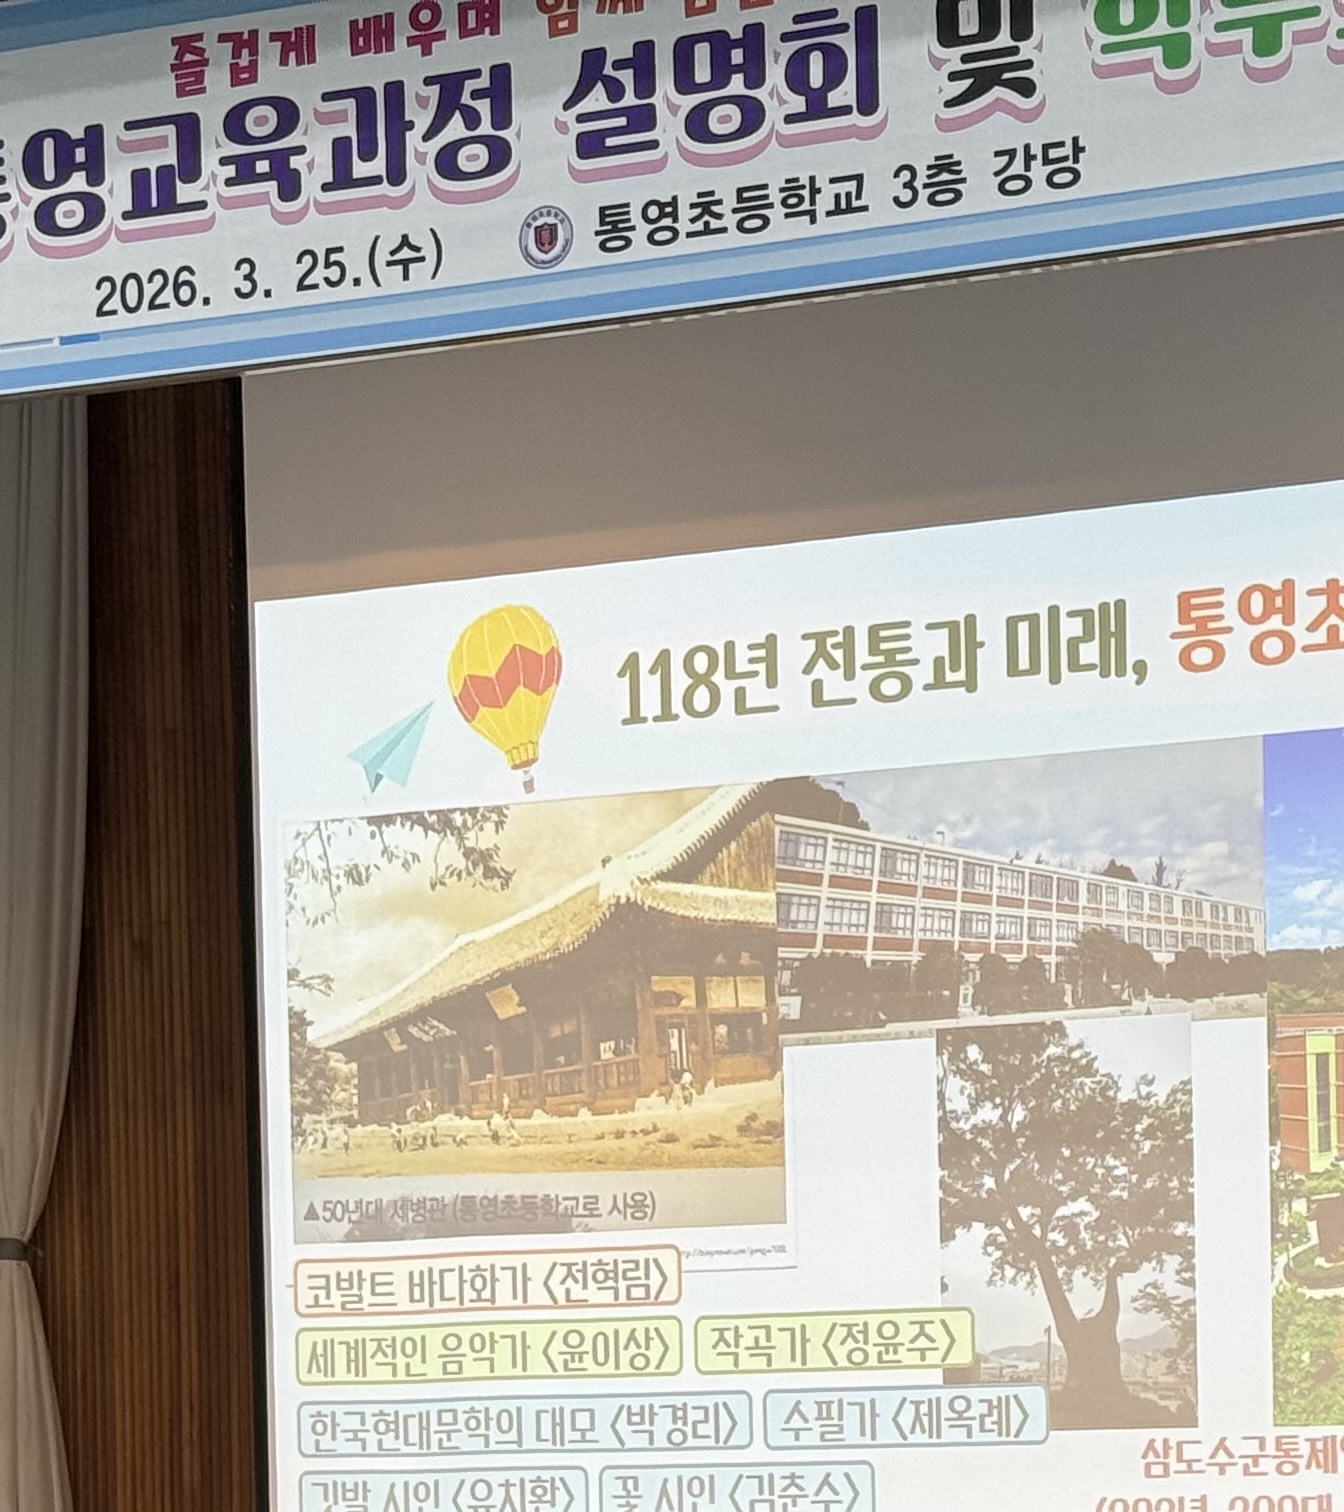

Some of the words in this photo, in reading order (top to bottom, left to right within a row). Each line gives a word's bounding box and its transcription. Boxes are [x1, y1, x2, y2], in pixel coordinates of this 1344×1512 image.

[170, 24, 317, 98] 즐겁게
[349, 0, 501, 57] 배우며
[562, 3, 880, 160] 설명회
[936, 0, 1037, 108] 및
[593, 172, 869, 254] 통영초등학교
[892, 153, 968, 210] 3층
[992, 136, 1087, 196] 강당
[95, 265, 211, 317] 2026.
[234, 257, 273, 300] 3.
[616, 632, 780, 726] 118년
[801, 613, 985, 709] 전통과
[1005, 598, 1148, 687] 미래,
[453, 1192, 603, 1222] (통영초등학교로
[607, 1190, 656, 1221] 사용)
[304, 1269, 398, 1311] 코발트
[408, 1261, 532, 1308] 바다화가
[307, 1334, 428, 1379] 세계적인
[437, 1331, 531, 1376] 음악가
[710, 1323, 811, 1370] 작곡가
[309, 1406, 523, 1453] 한국현대문학의
[535, 1405, 599, 1448] 대모
[780, 1398, 881, 1443] 수필가
